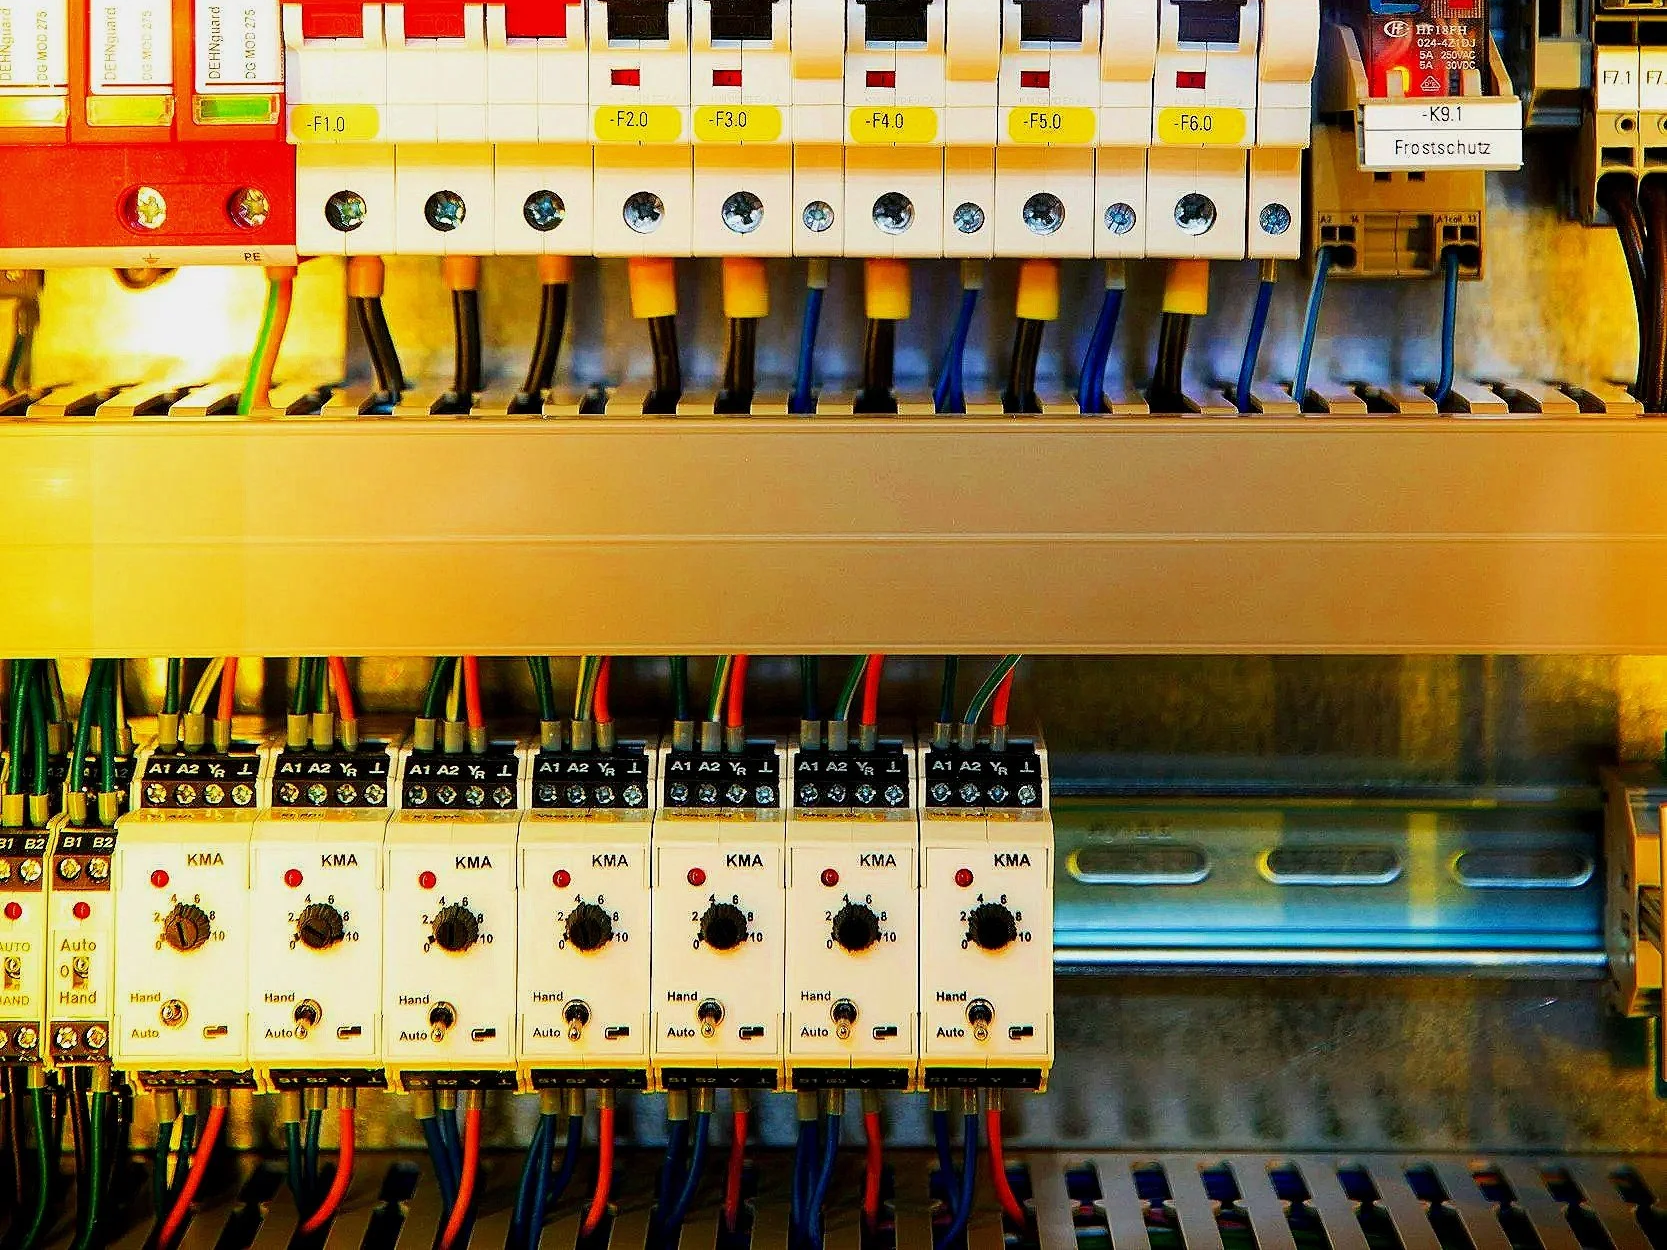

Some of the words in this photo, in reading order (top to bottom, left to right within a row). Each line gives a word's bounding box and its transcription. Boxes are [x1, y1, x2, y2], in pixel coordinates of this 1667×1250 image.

[245, 9, 256, 29] 275
[208, 6, 224, 79] DEHNguard
[1420, 51, 1434, 59] 5A
[245, 62, 256, 79] DG
[1420, 61, 1434, 69] 5A
[1603, 70, 1630, 85] F7.1
[1422, 106, 1462, 121] -K9.1
[306, 116, 345, 132] -F1.0
[609, 111, 648, 128] -F2.0
[709, 111, 747, 128] -F3.0
[865, 112, 904, 129] -F4.0
[1023, 113, 1061, 130] -F5.0
[1174, 115, 1213, 131] -F6.0
[1395, 139, 1491, 155] Frostschutz
[244, 252, 261, 261] PE
[149, 763, 171, 774] A1
[177, 763, 200, 774] A2
[281, 763, 301, 773] A1
[308, 763, 330, 773] A2
[409, 764, 430, 775] A1
[437, 764, 459, 775] A2
[539, 763, 560, 773] A1
[567, 763, 589, 773] A2
[671, 761, 691, 771] A1
[698, 761, 720, 771] A2
[799, 761, 819, 771] A1
[826, 761, 847, 771] A2
[932, 761, 952, 770] A1
[959, 761, 981, 771] A2
[25, 838, 45, 849] B2
[63, 836, 82, 848] B1
[93, 836, 114, 848] B2
[187, 853, 224, 867] KMA
[321, 854, 358, 867] KMA
[455, 856, 492, 869] KMA
[592, 854, 628, 867] KMA
[726, 854, 763, 867] KMA
[860, 854, 897, 867] KMA
[994, 854, 1031, 867] KMA
[977, 894, 983, 904] 4
[1000, 894, 1007, 904] 6
[960, 912, 966, 921] 2
[1015, 912, 1022, 921] 8
[213, 931, 225, 941] 10
[616, 932, 628, 942] 10
[1019, 932, 1032, 942] 10
[60, 938, 97, 951] Auto
[961, 940, 968, 950] 0
[0, 995, 30, 1006] AND
[60, 991, 97, 1004] Hand
[130, 992, 161, 1003] Hand
[264, 992, 295, 1003] Hand
[399, 994, 430, 1005] Hand
[533, 991, 563, 1002] Hand
[667, 991, 698, 1001] Hand
[800, 990, 831, 1001] Hand
[936, 991, 967, 1002] Hand
[131, 1028, 159, 1038] Auto
[265, 1027, 293, 1038] Auto
[399, 1030, 427, 1040] Auto
[533, 1027, 561, 1038] Auto
[667, 1027, 695, 1038] Auto
[800, 1027, 829, 1038] Auto
[936, 1027, 965, 1038] Auto
